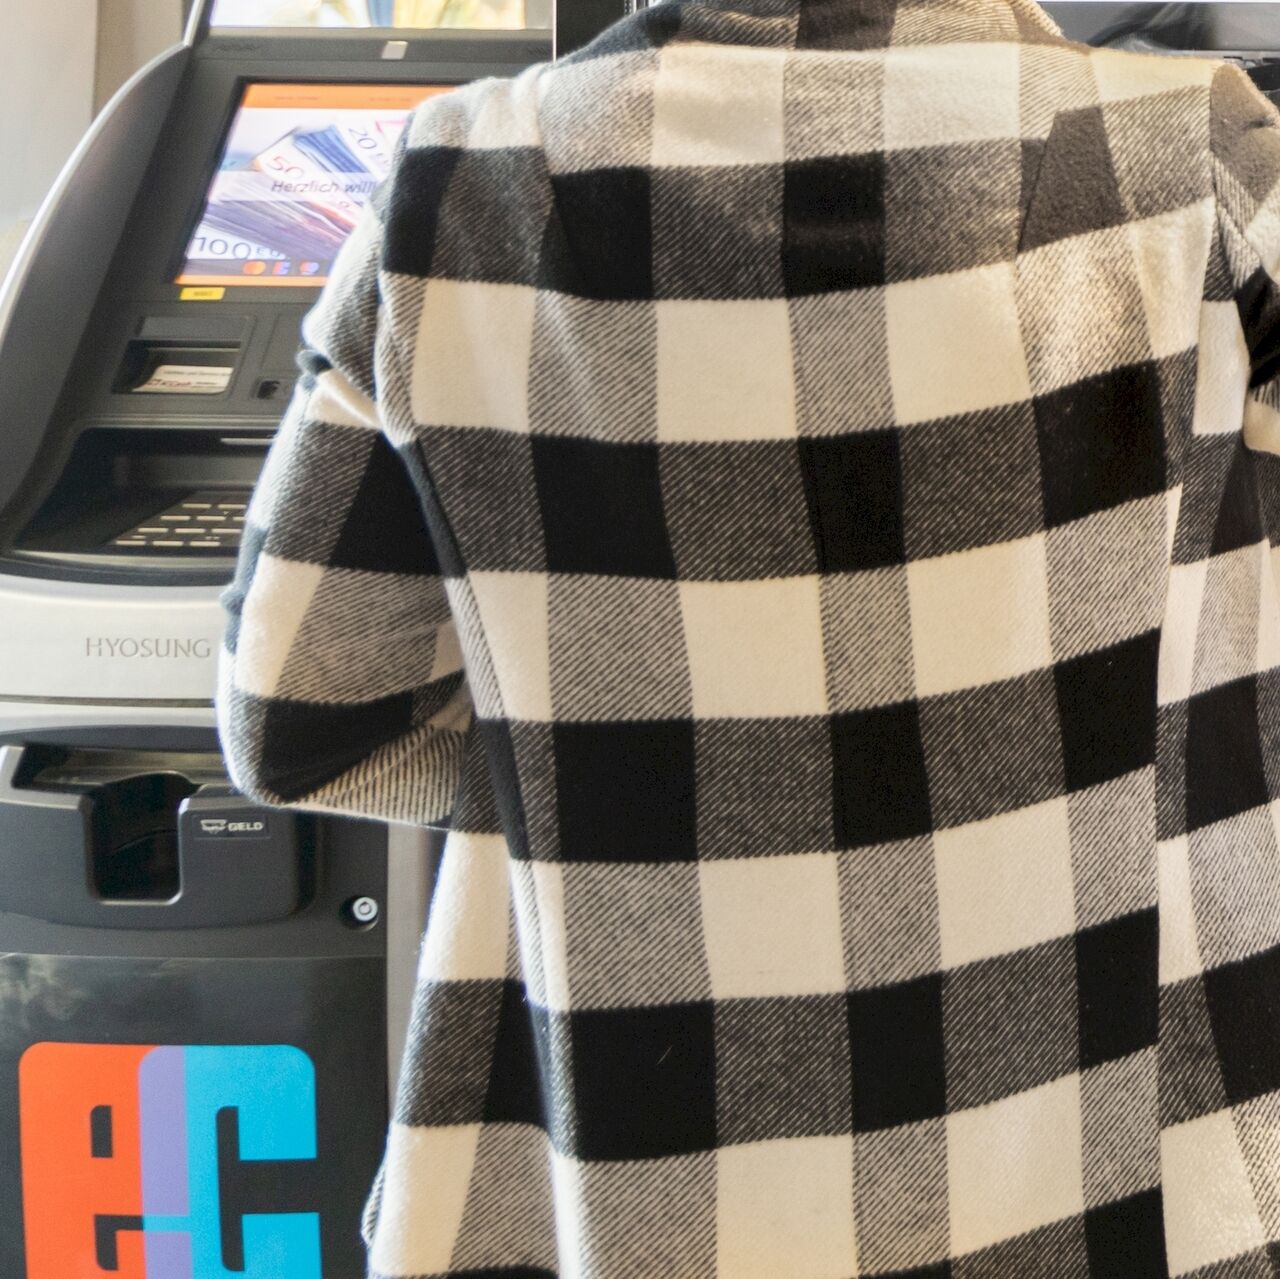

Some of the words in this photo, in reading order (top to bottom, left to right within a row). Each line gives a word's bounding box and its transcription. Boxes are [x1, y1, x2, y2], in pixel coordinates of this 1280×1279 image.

[271, 180, 339, 194] Herzlich
[86, 637, 211, 660] HYOSUNG
[228, 821, 264, 831] GELD
